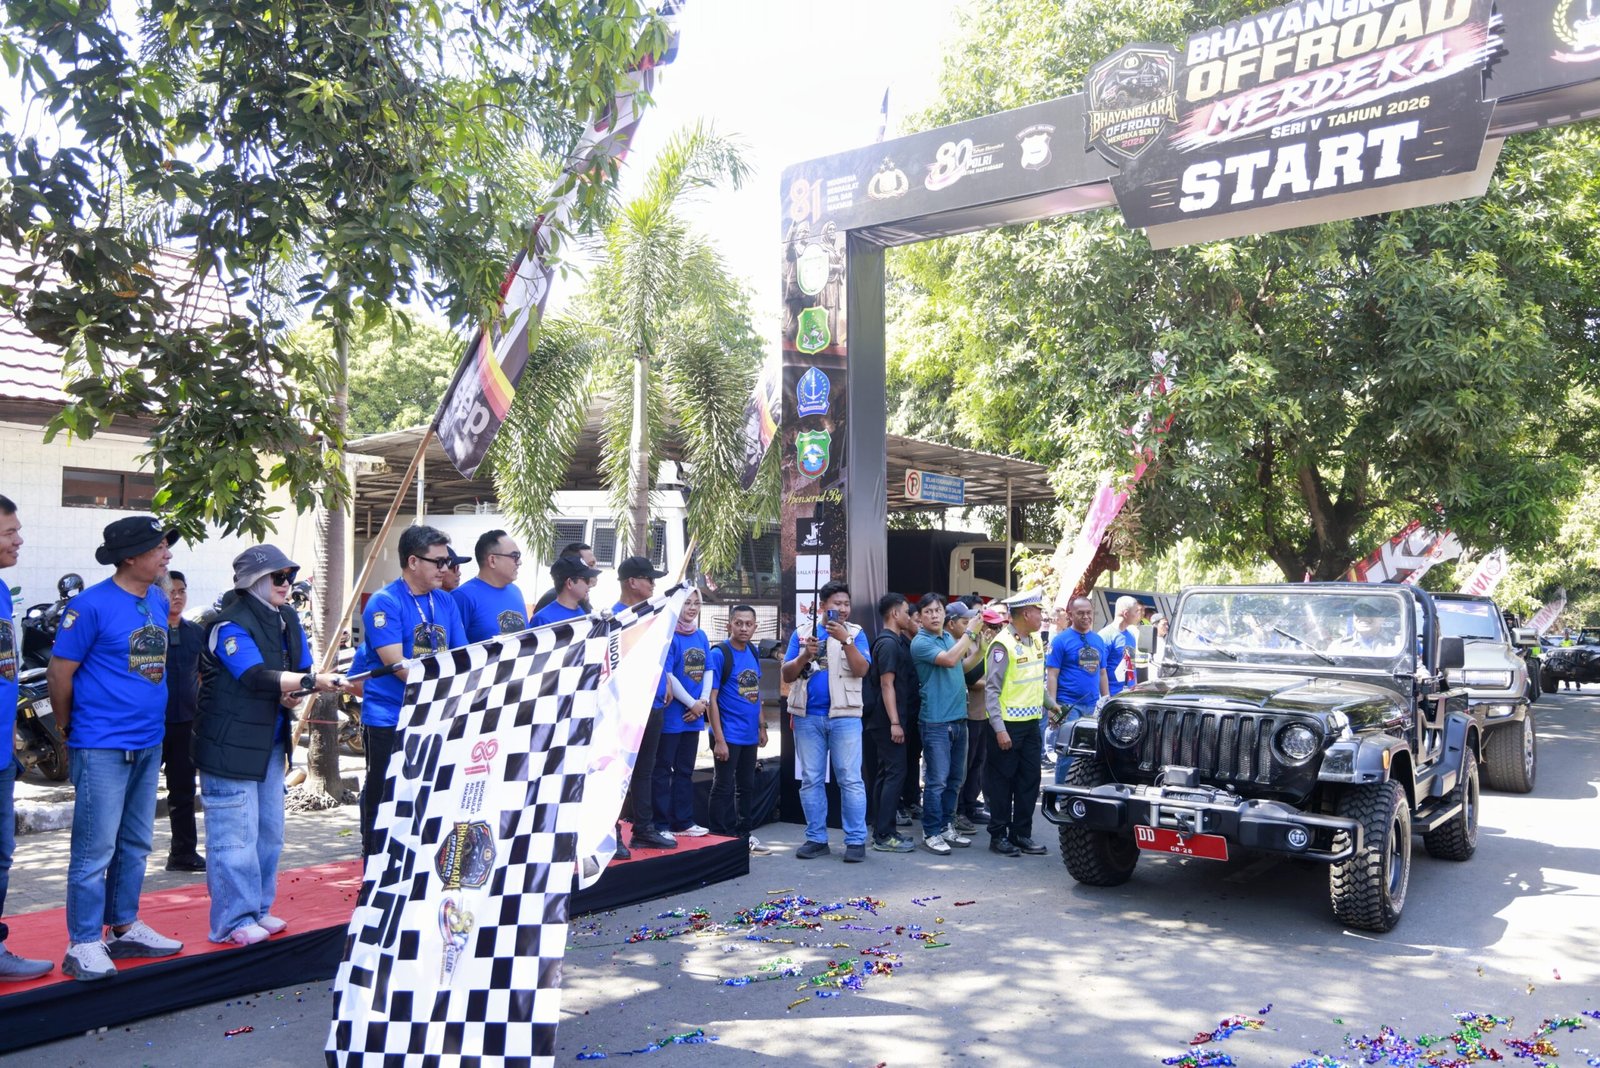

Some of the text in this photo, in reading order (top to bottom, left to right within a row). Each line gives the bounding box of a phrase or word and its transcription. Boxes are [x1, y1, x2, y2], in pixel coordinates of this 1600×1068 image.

[1185, 0, 1472, 103] OFFROAD
[1203, 33, 1452, 136] MERDEKA
[1092, 95, 1175, 138] BHAYANGKARA
[1106, 116, 1160, 138] OFFROAD
[1108, 131, 1138, 145] MERDEKA
[1139, 128, 1153, 136] SERI
[1270, 95, 1430, 139] SERI V TAHUN 2026
[1121, 137, 1146, 148] 2026
[1179, 121, 1420, 213] START
[827, 487, 843, 505] By
[464, 738, 499, 776] 81
[476, 780, 486, 812] INDONESIA
[445, 834, 457, 878] OFFROAD
[449, 823, 469, 889] BHAYANGKARA
[1137, 827, 1156, 842] DD
[350, 733, 443, 1013] START
